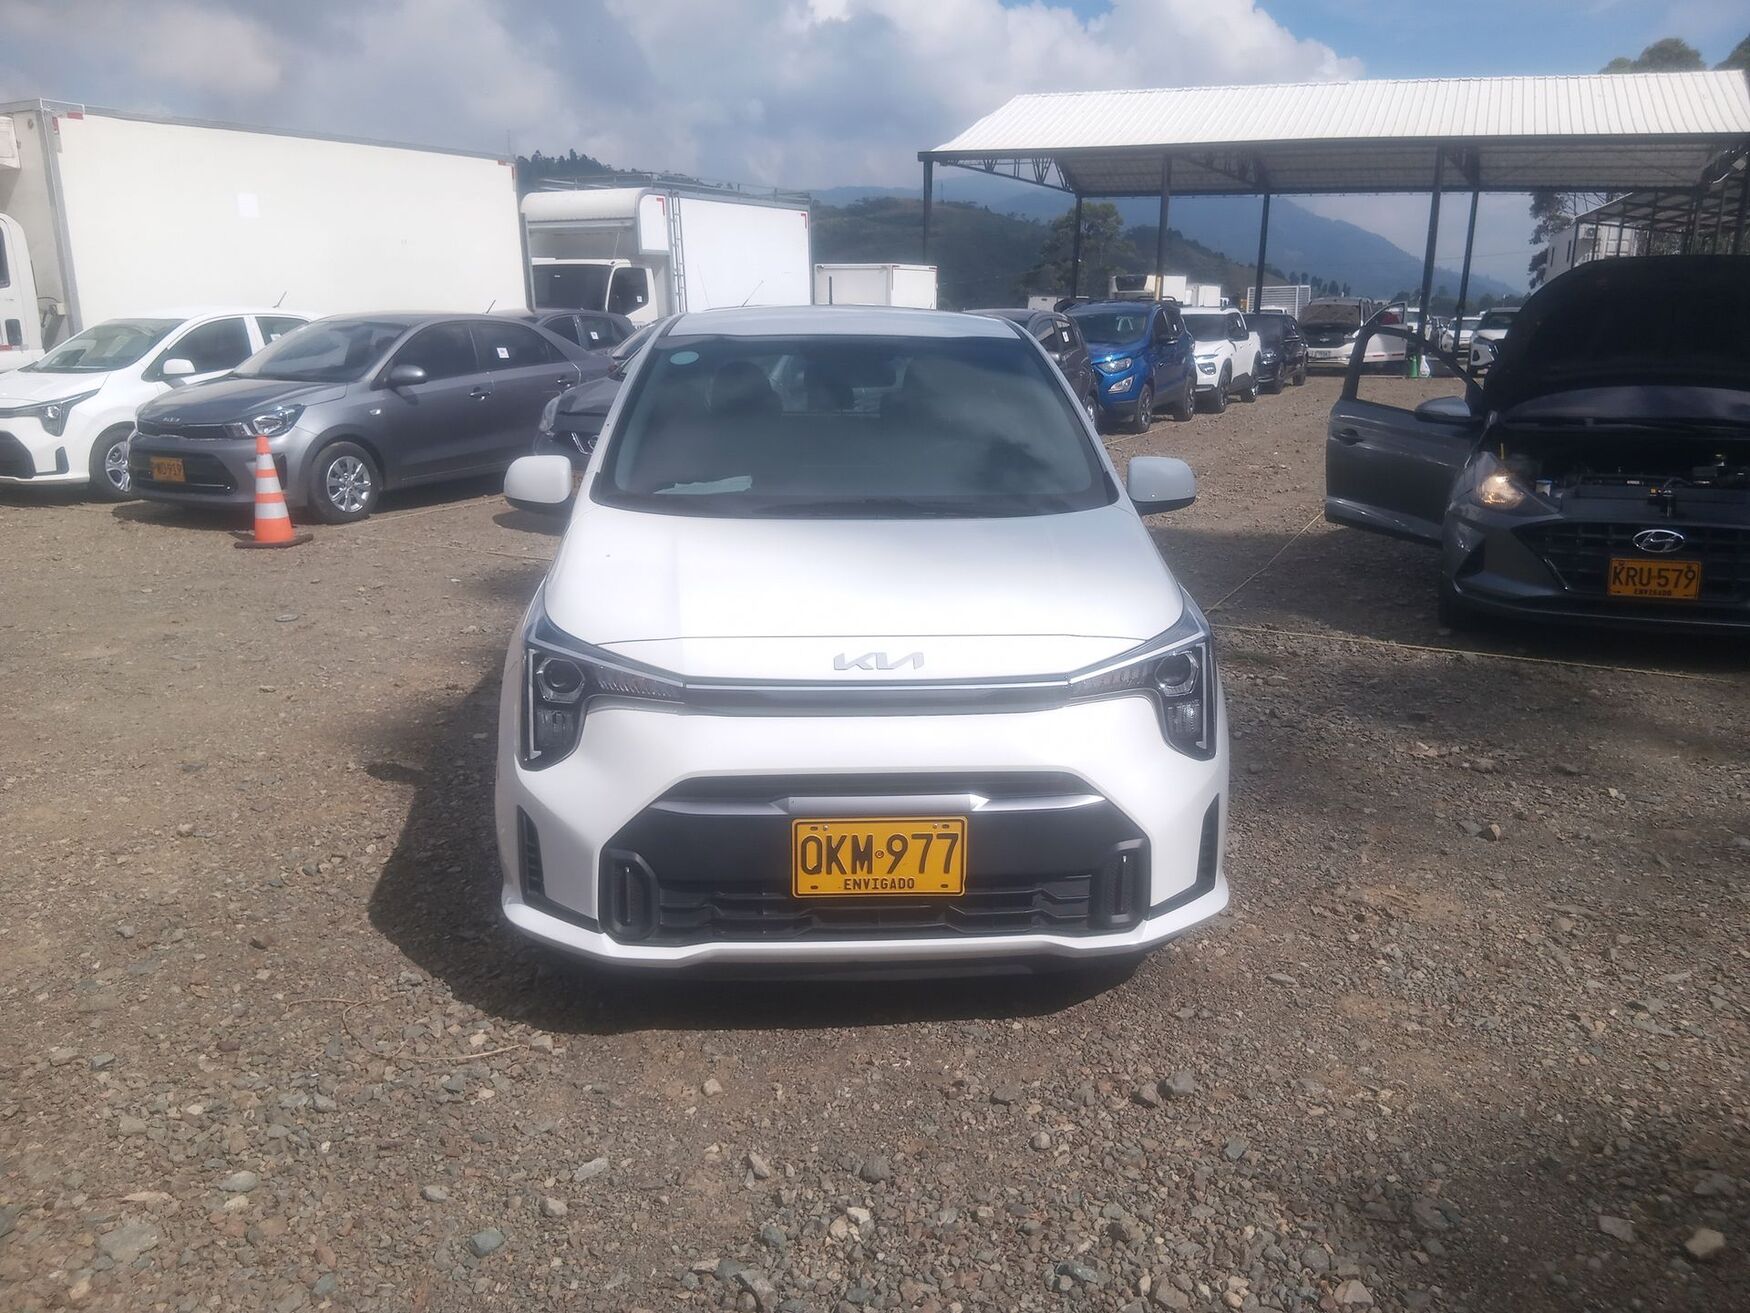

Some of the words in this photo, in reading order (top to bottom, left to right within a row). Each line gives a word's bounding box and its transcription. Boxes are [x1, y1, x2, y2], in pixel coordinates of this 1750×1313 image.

[833, 651, 925, 671] KIA
[886, 832, 960, 875] 977
[843, 877, 916, 891] ENVIGADO
